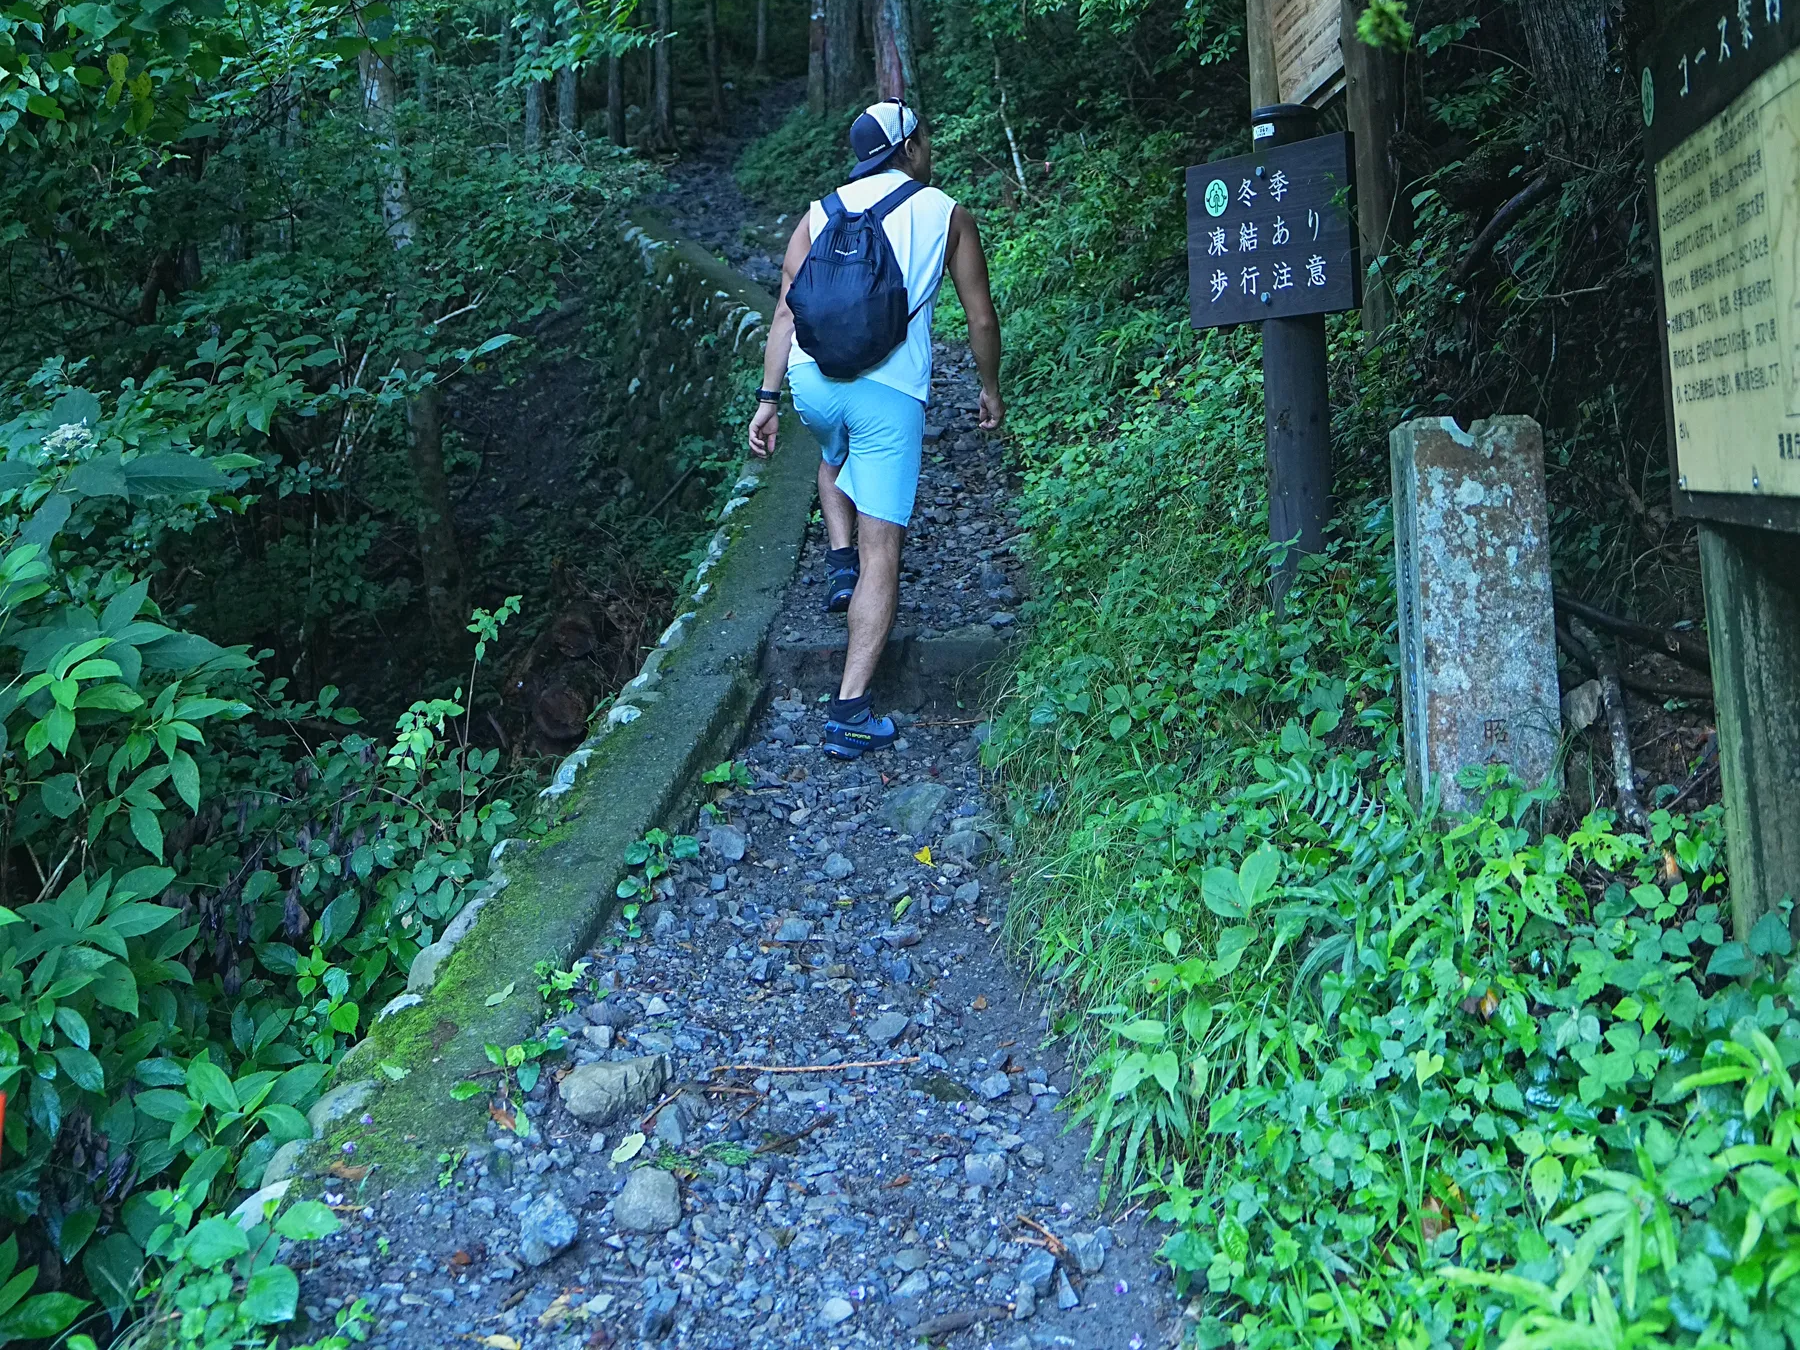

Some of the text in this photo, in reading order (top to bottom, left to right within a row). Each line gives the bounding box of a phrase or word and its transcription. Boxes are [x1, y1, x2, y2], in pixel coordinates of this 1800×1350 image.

[1236, 169, 1290, 207] 冬季
[1206, 208, 1320, 257] 凍結あり
[1209, 254, 1328, 303] 歩行注意
